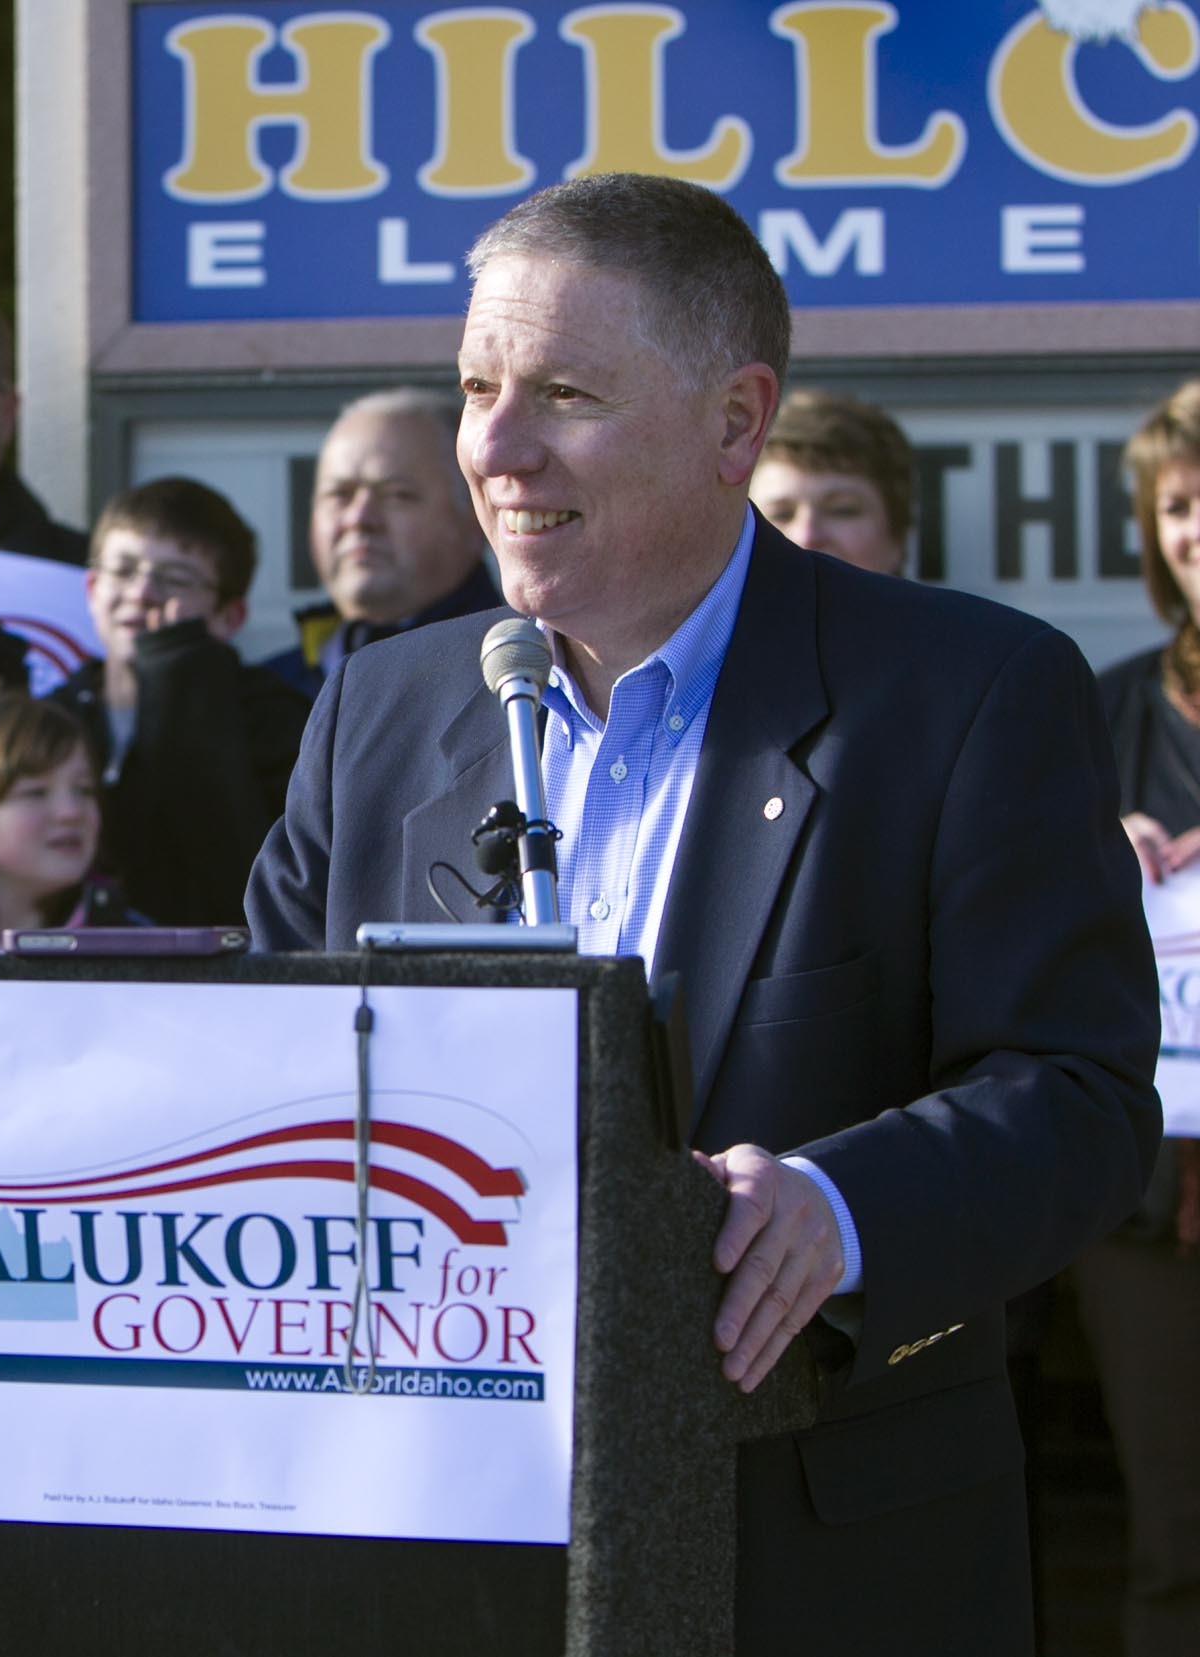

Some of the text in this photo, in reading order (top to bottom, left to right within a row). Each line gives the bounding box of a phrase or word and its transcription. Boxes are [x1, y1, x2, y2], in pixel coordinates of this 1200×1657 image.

[163, 1, 1198, 202] HILLC
[187, 205, 1085, 287] ELME
[430, 1248, 508, 1310] for
[93, 1292, 543, 1366] GOVERNOR
